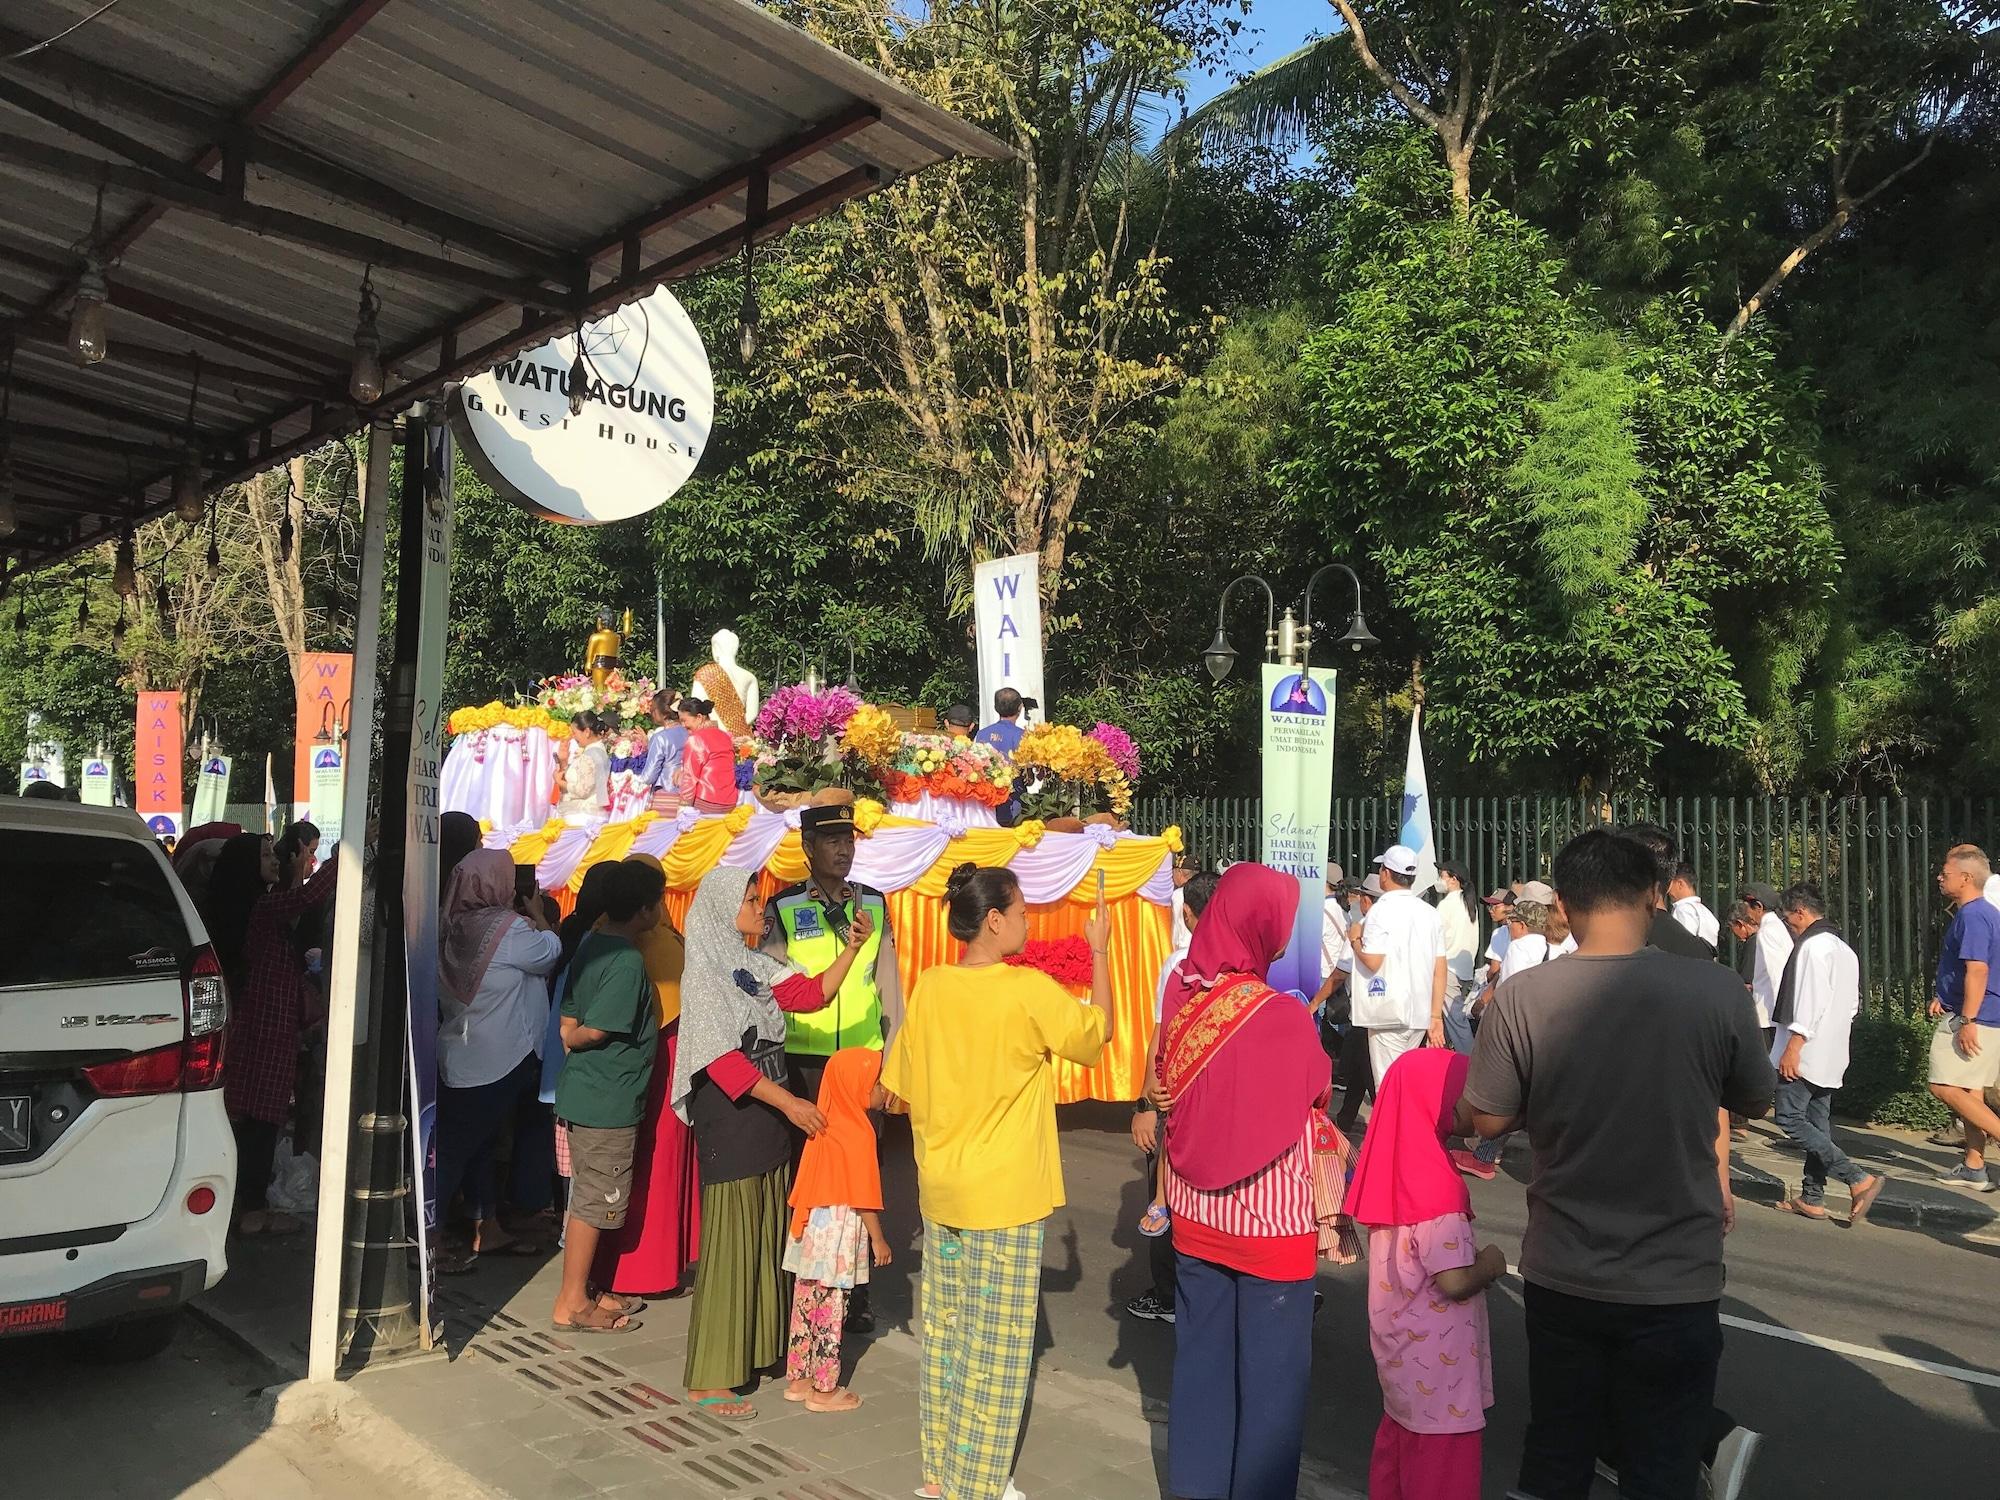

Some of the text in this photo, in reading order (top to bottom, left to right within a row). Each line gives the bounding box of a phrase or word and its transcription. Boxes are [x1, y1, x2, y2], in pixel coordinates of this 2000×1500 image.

[1271, 715, 1326, 727] WALUBI
[149, 699, 169, 802] WAISAK
[1270, 839, 1296, 848] HARI
